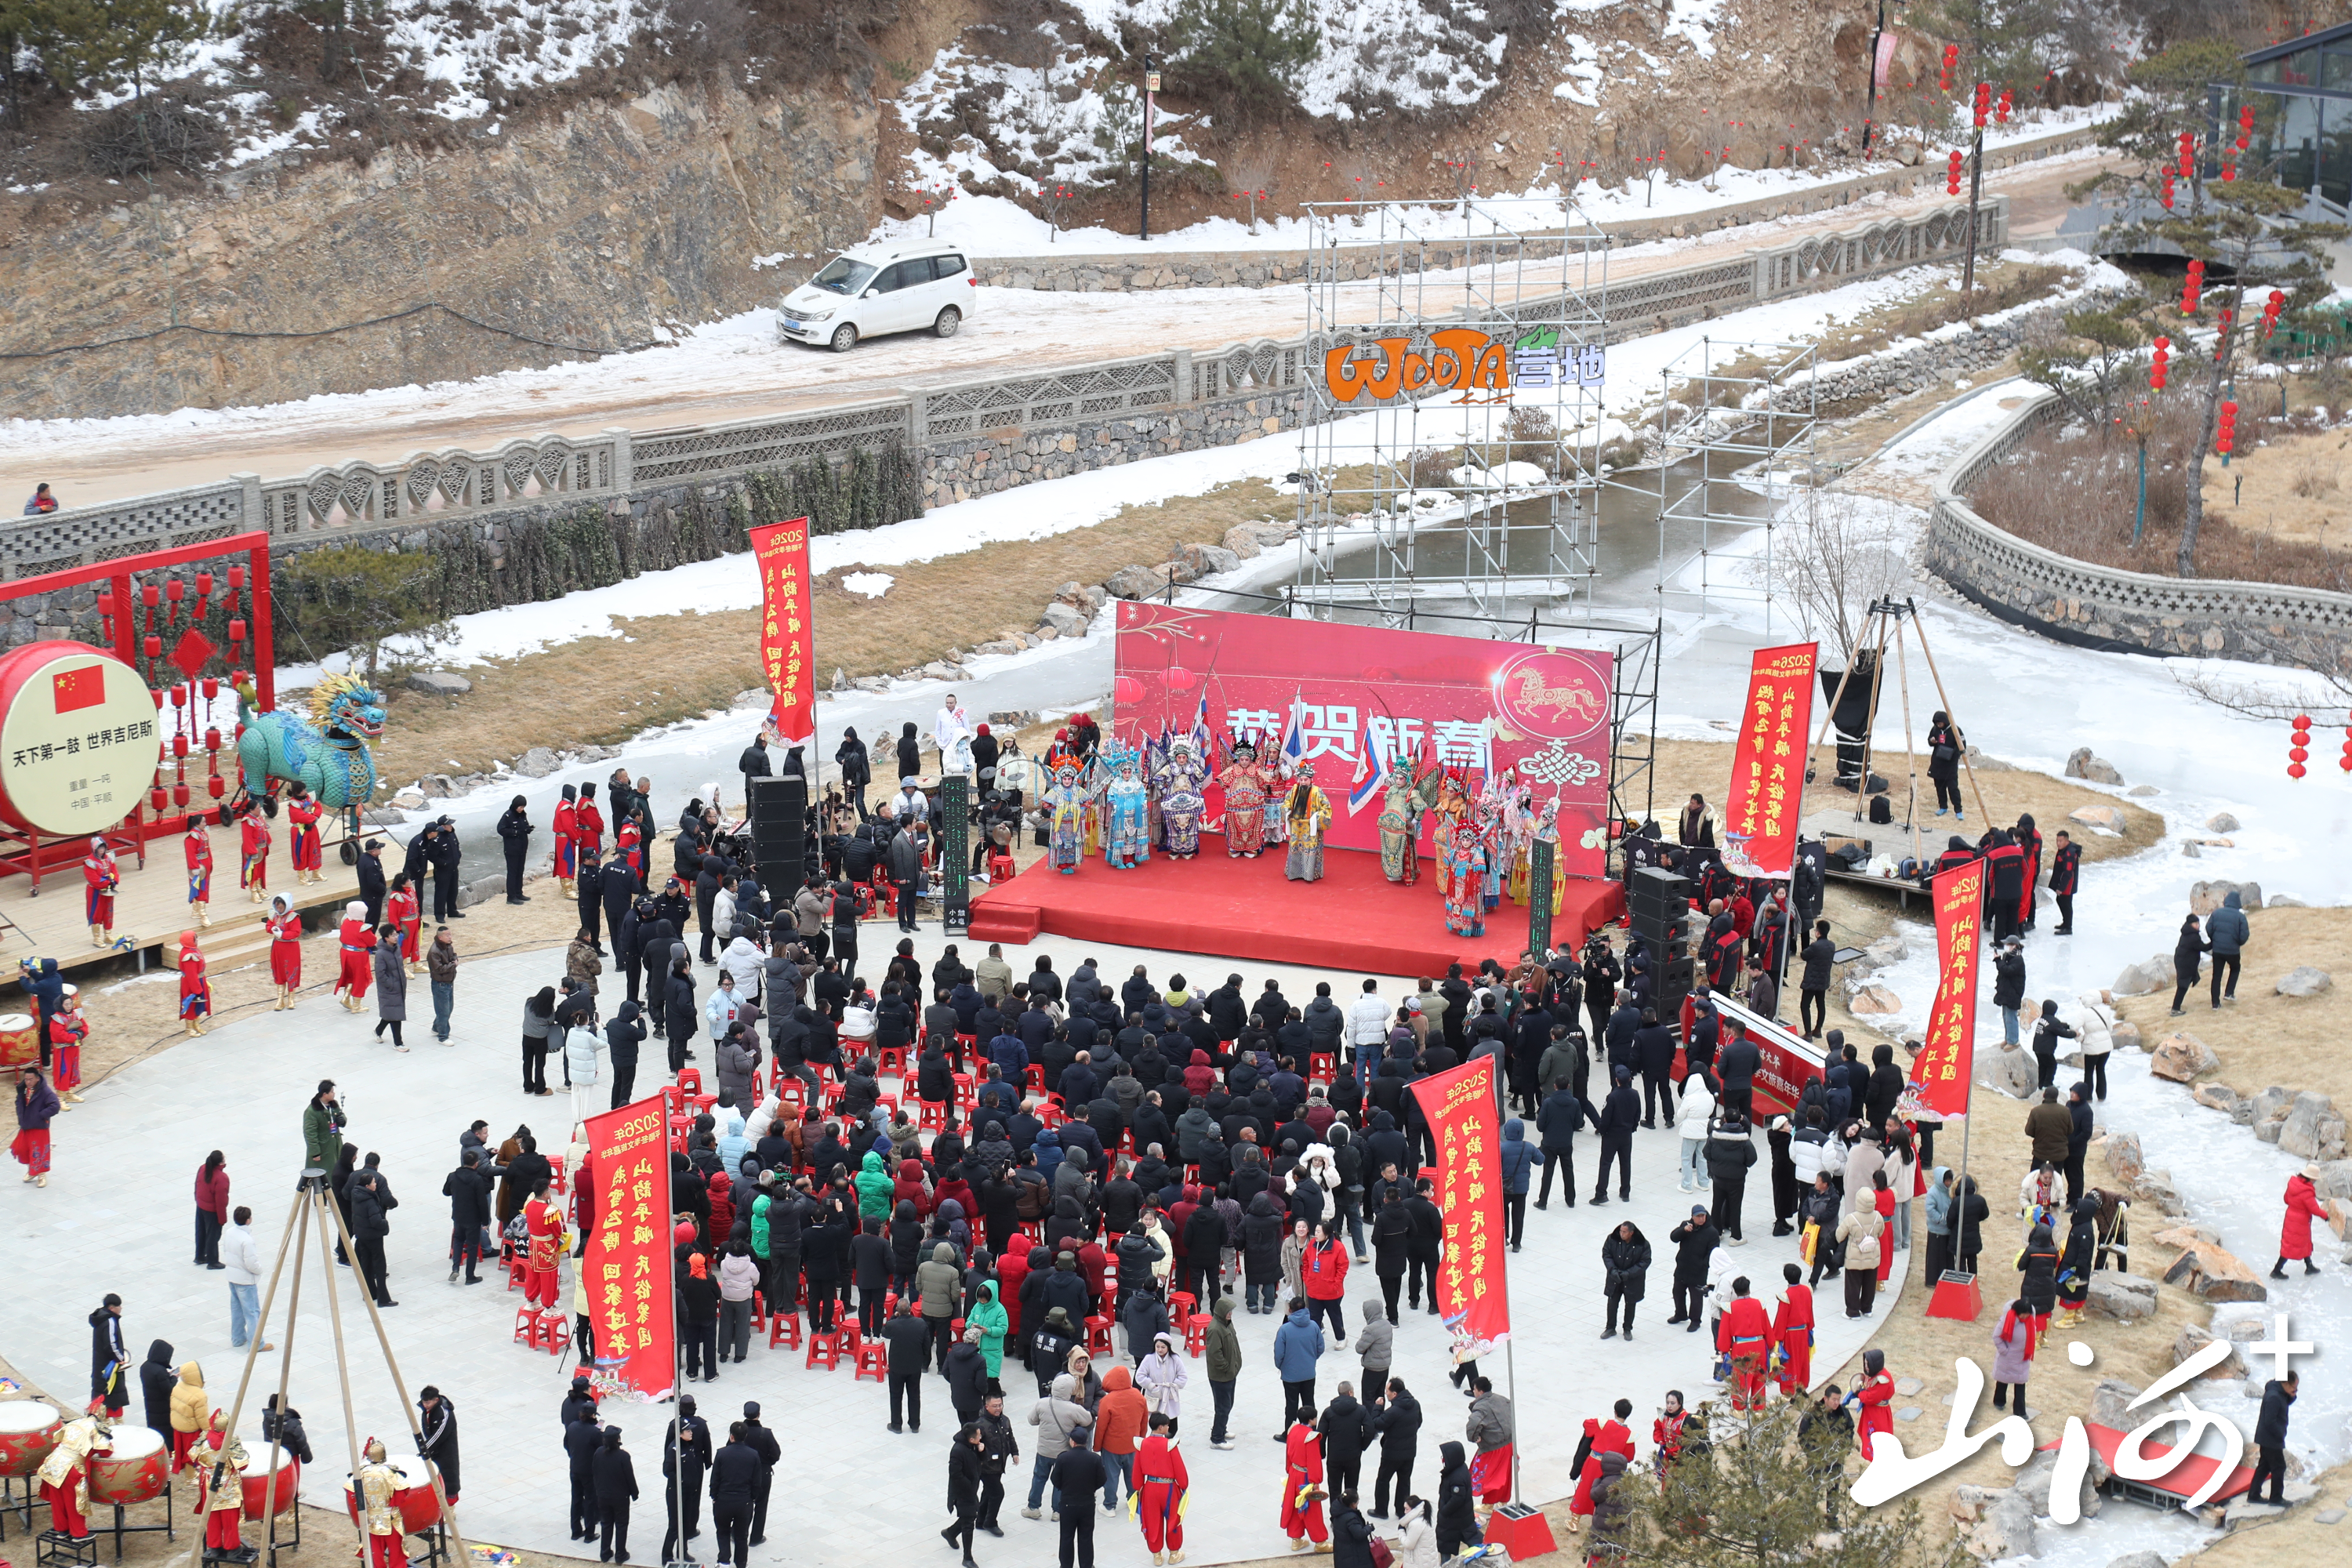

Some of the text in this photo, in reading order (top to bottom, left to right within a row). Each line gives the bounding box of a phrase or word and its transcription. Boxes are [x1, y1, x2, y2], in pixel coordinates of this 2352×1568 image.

[1514, 343, 1606, 388] 营地
[13, 720, 153, 768] 天下第一鼓 世界吉尼斯
[1226, 702, 1486, 768] 恭贺新春
[69, 773, 111, 793] 重量 一吨
[71, 792, 113, 810] 中国·平顺
